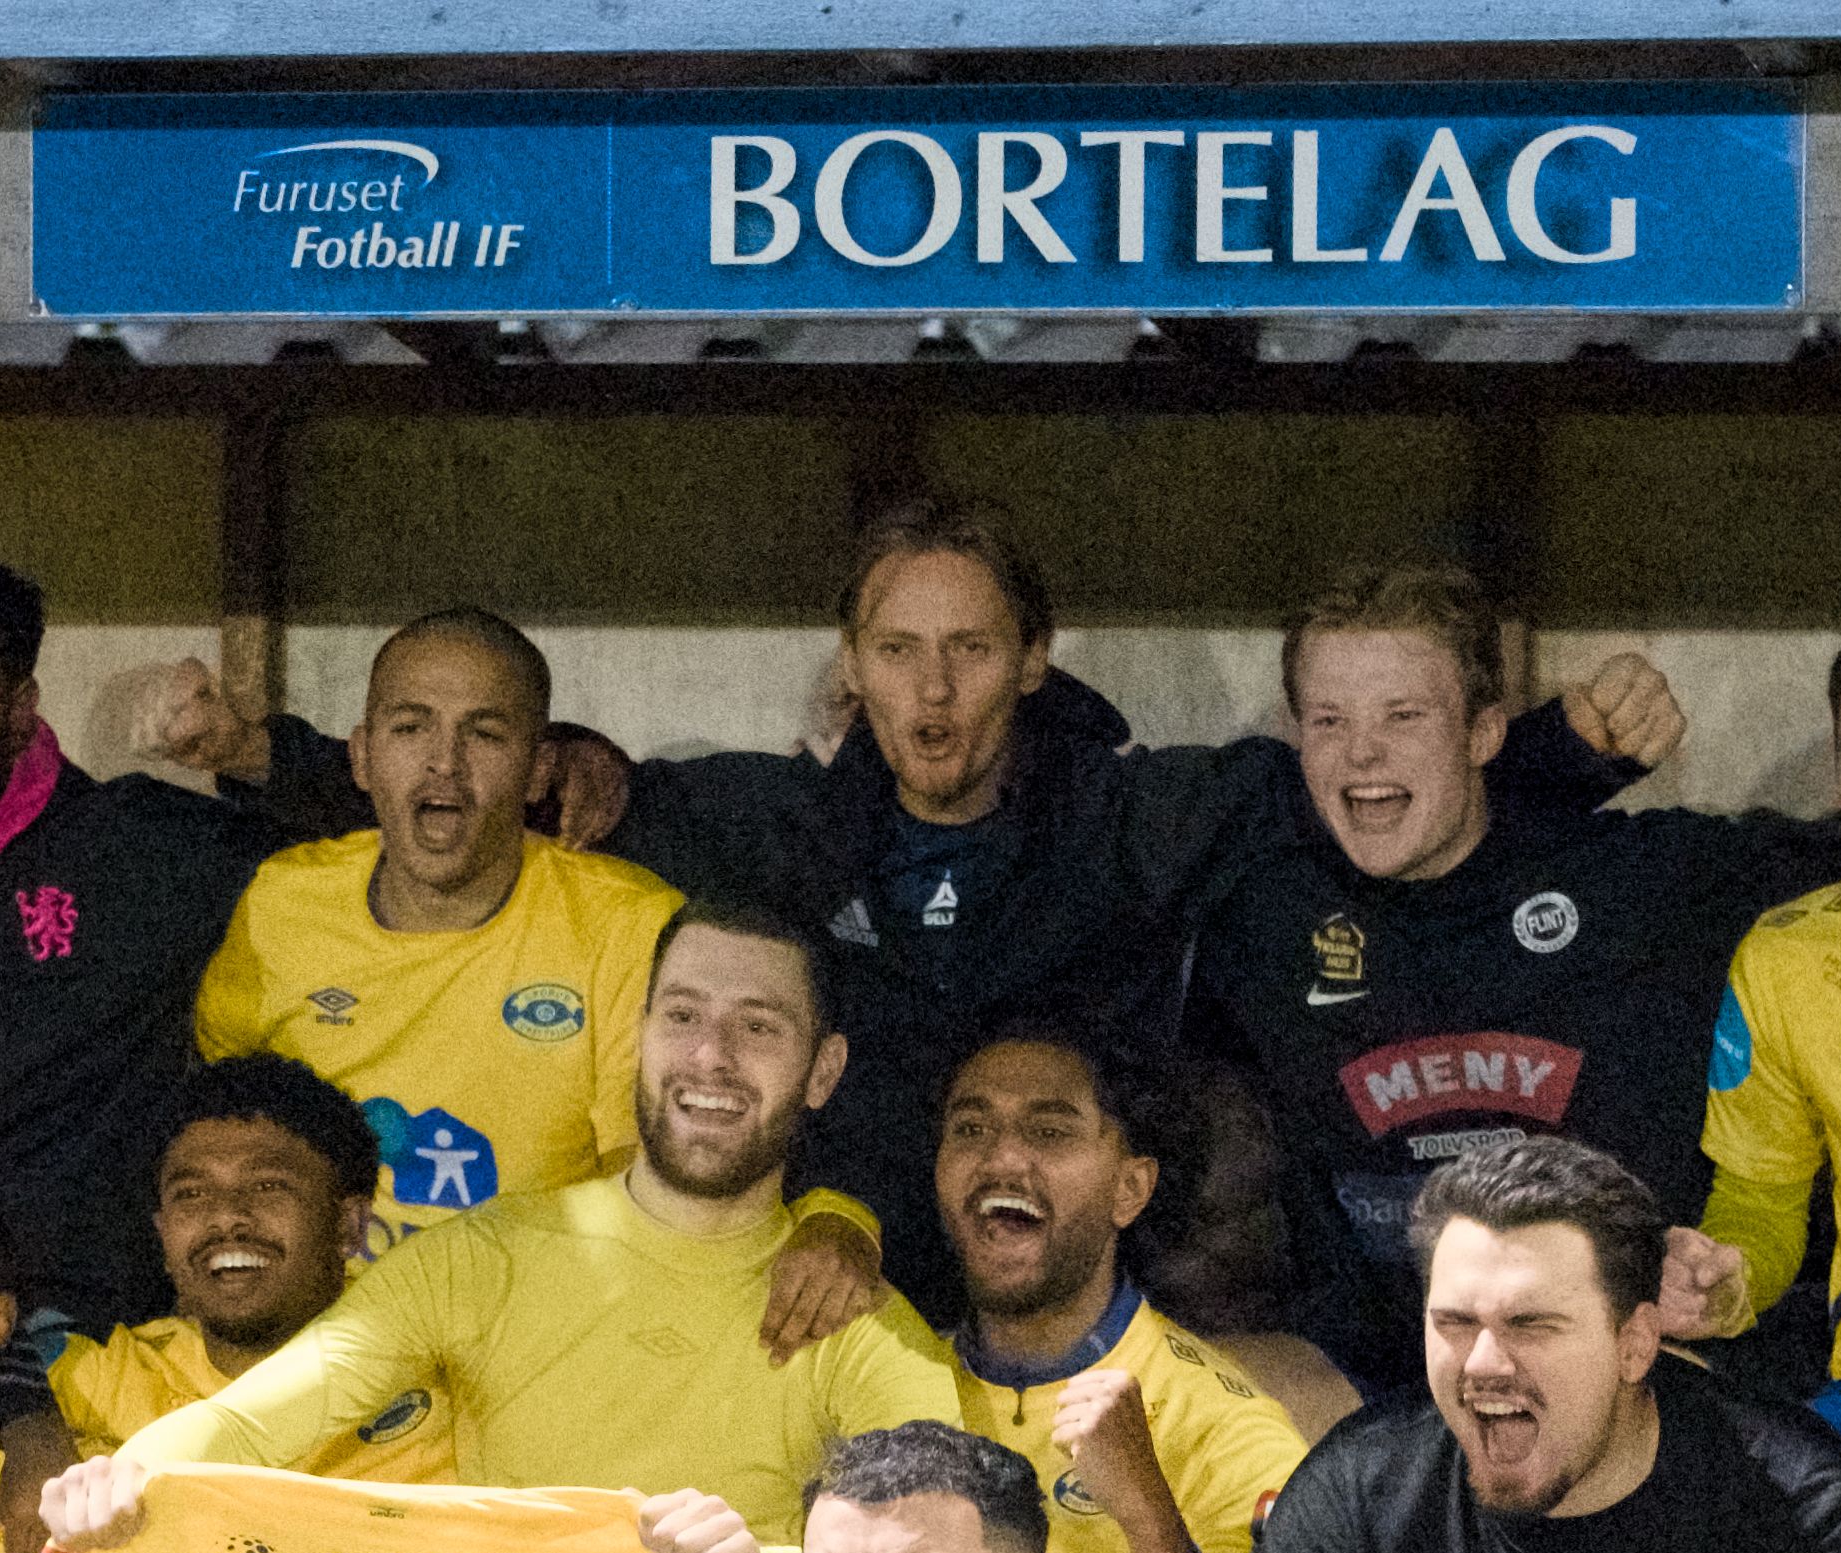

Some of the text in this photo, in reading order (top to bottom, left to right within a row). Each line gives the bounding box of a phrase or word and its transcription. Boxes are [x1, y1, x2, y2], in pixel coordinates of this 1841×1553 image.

[233, 170, 405, 213] Furuset
[709, 124, 1639, 267] BORTELAG
[290, 220, 525, 269] Fotball IF
[1364, 1049, 1557, 1113] MENY
